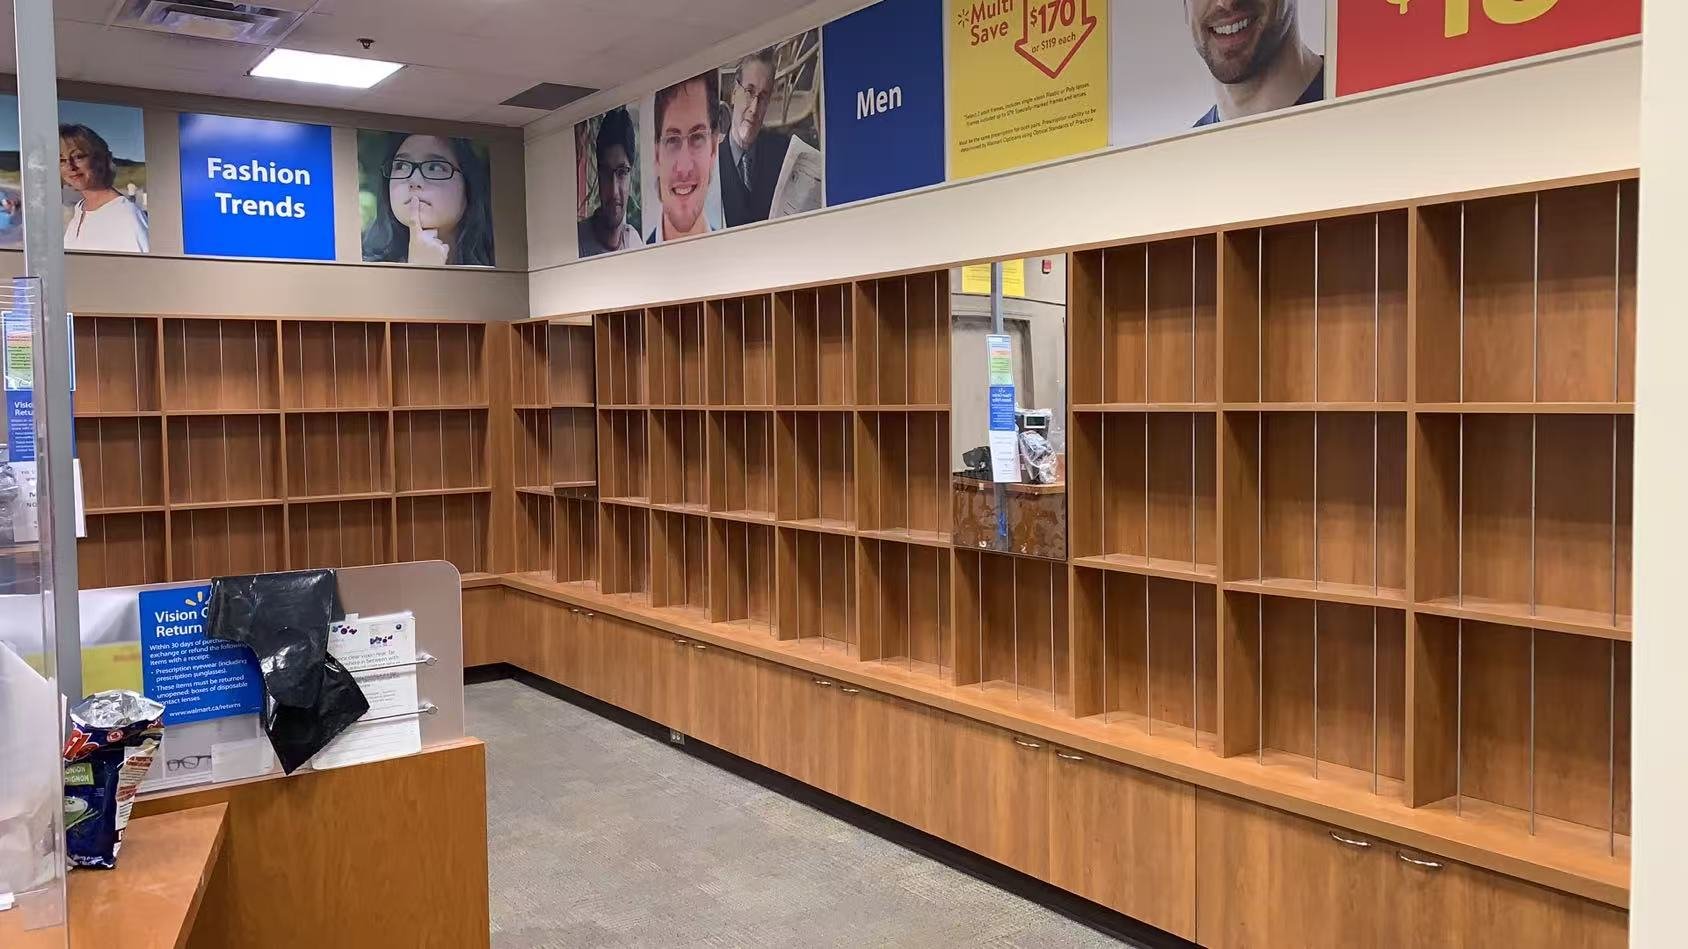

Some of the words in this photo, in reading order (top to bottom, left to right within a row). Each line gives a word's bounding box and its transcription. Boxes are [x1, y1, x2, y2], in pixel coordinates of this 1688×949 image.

[971, 0, 1013, 24] Multi
[1030, 0, 1076, 34] $170
[971, 20, 1009, 46] Save
[1031, 45, 1039, 53] or
[1058, 31, 1076, 45] each
[857, 86, 901, 120] Men
[207, 157, 311, 185] Fashion
[215, 192, 306, 218] Trends
[154, 609, 198, 623] Vision
[156, 624, 203, 638] Return
[150, 650, 180, 659] exchange
[188, 645, 209, 654] refund
[180, 640, 194, 649] days
[155, 665, 192, 675] Prescription
[192, 662, 217, 670] eyewear
[156, 673, 192, 682] prescription
[156, 684, 175, 692] These
[176, 681, 192, 689] items
[218, 674, 245, 683] returned
[216, 681, 248, 691] disposable
[169, 702, 241, 717] www.walmart.ca/returns
[65, 766, 86, 775] ONION
